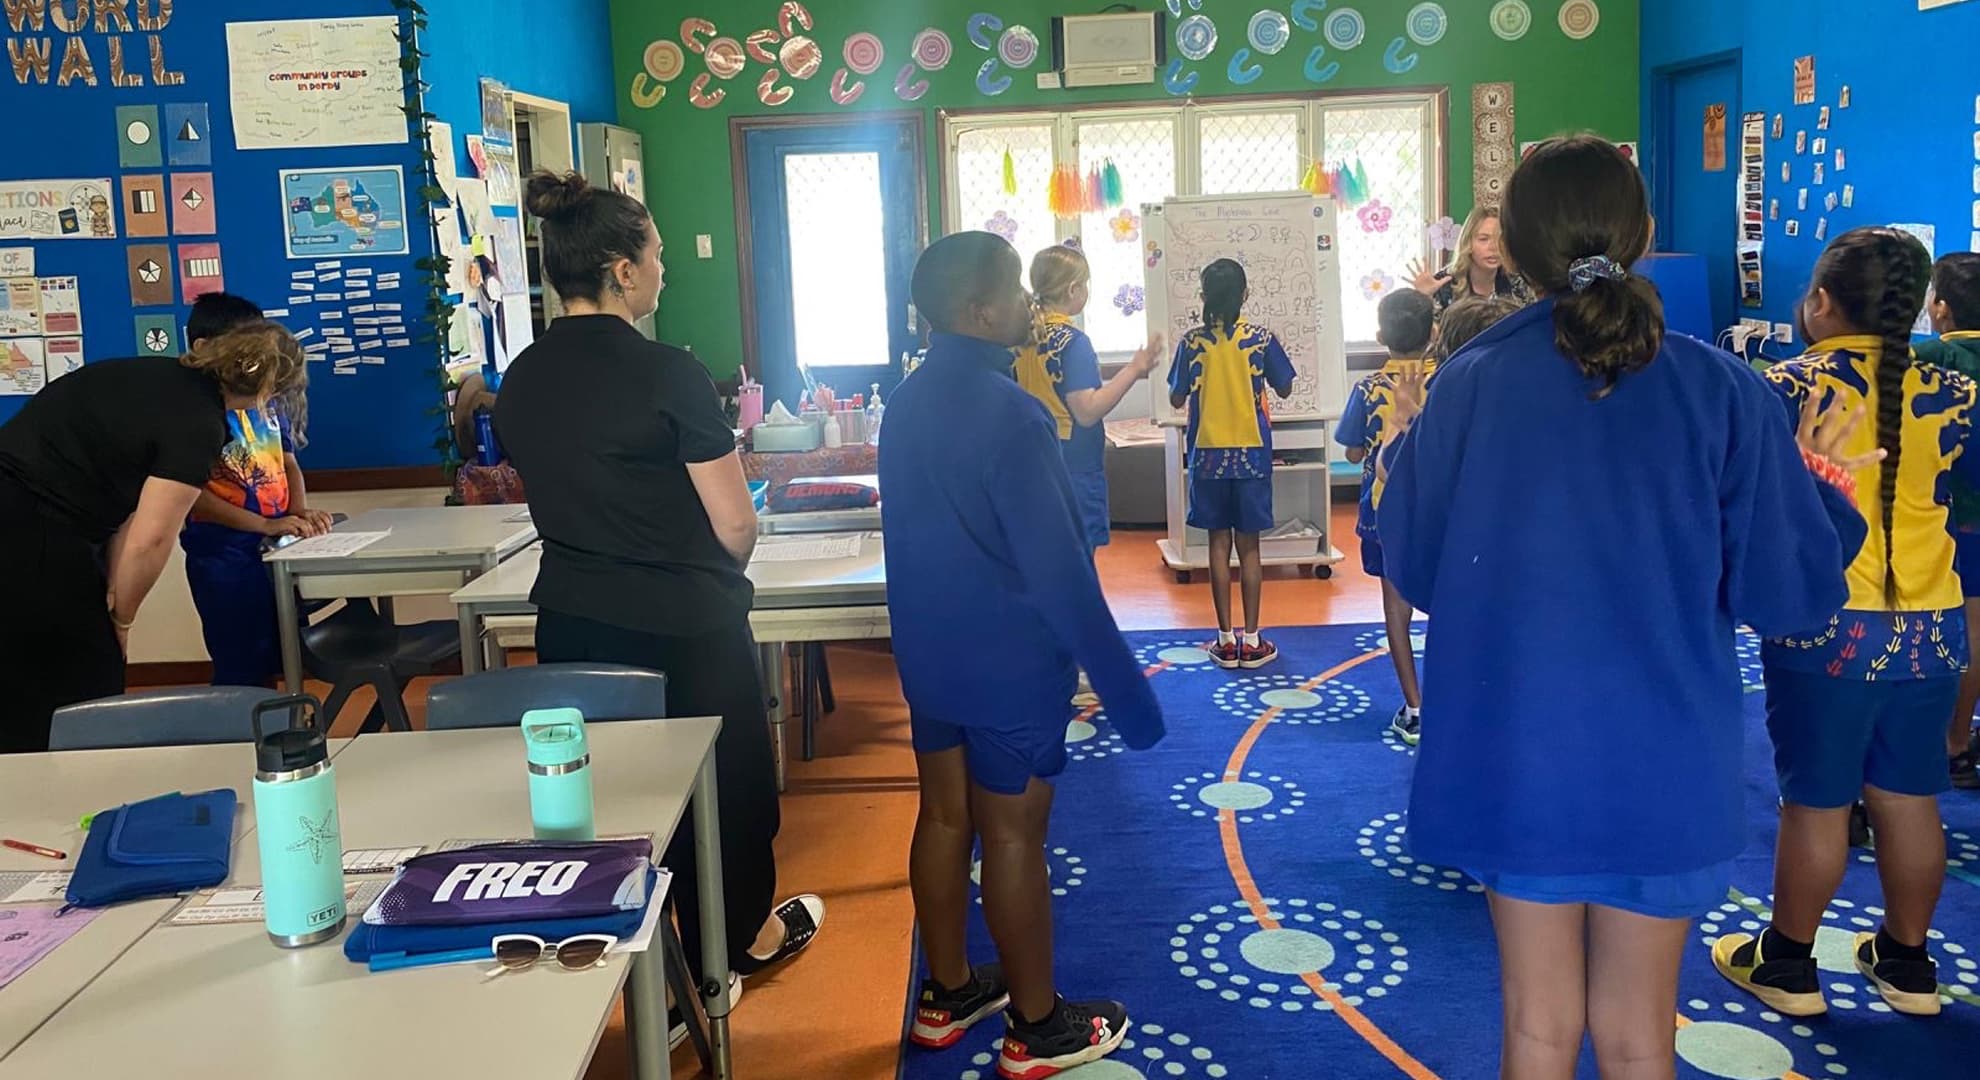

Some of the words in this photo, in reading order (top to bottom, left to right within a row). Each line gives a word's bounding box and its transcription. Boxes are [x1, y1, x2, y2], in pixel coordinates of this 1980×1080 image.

[3, 0, 173, 32] WORD
[7, 36, 185, 87] WALL
[432, 861, 589, 902] FREO
[310, 906, 336, 923] YETI
